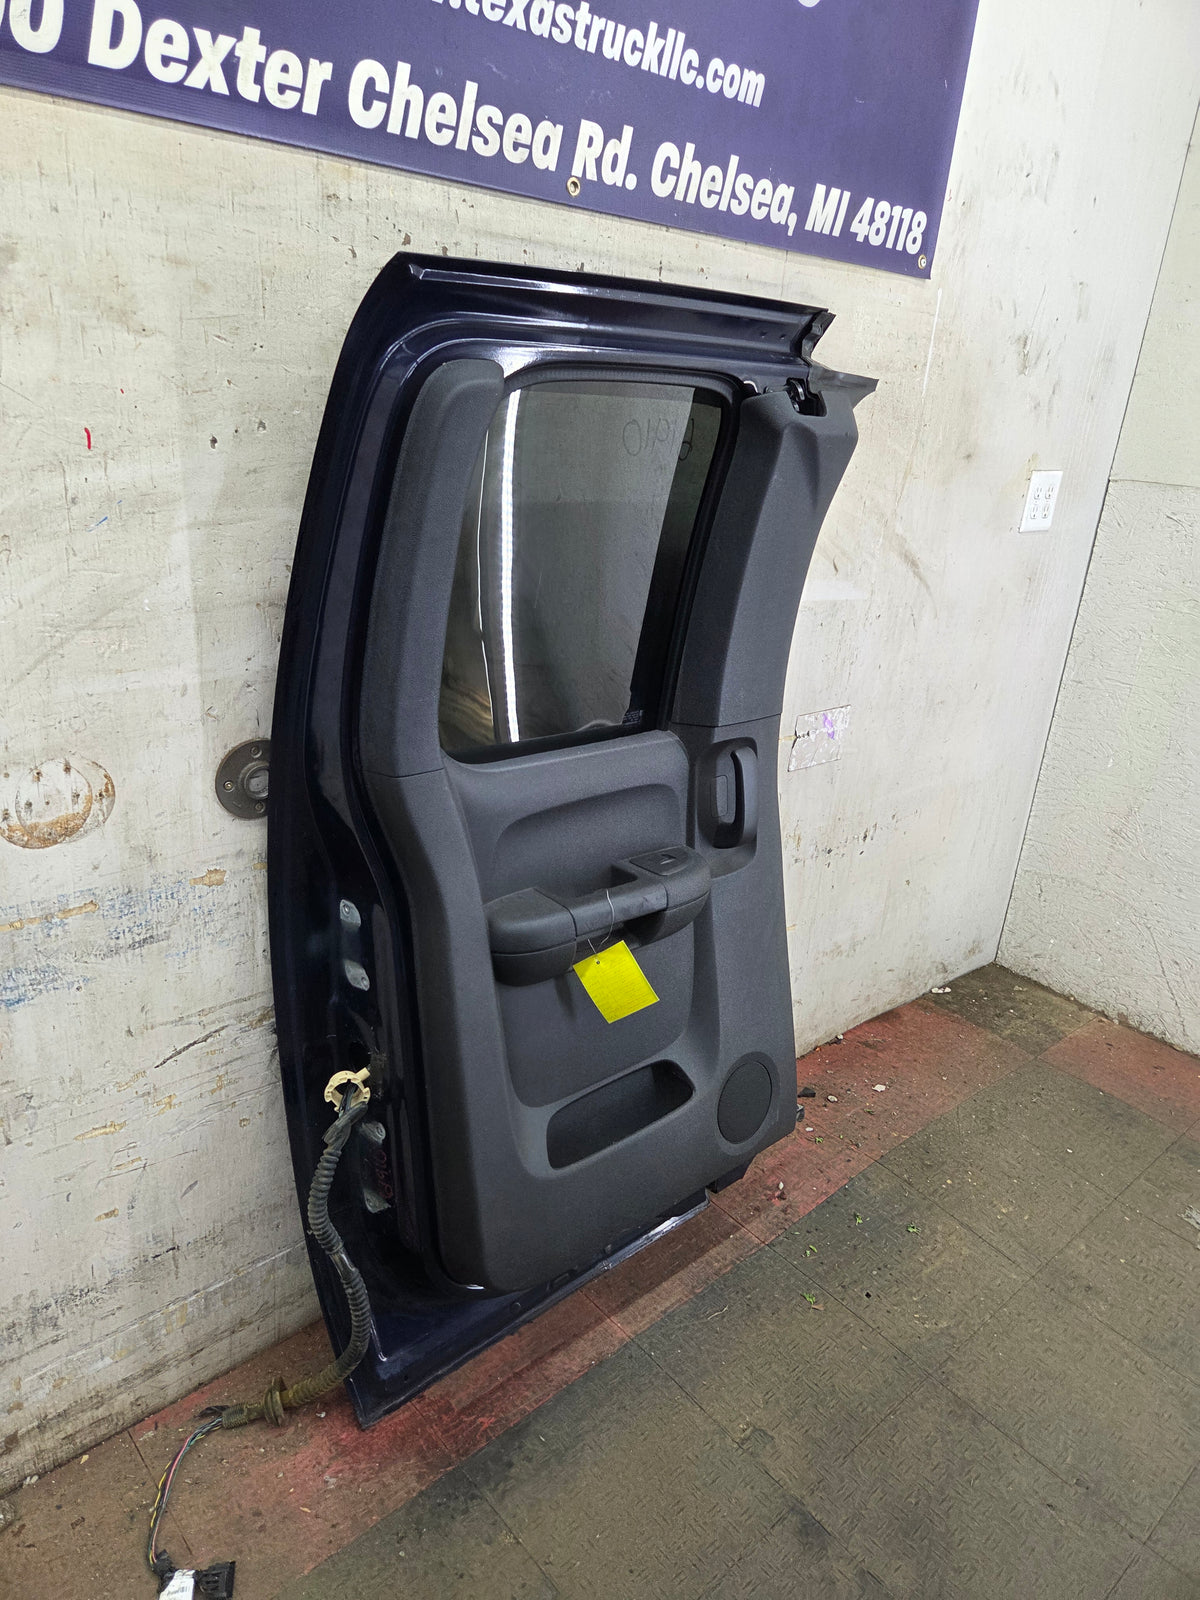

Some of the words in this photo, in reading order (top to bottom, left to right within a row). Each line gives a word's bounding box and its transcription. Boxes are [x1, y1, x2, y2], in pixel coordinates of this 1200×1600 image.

[0, 0, 64, 53] 0
[88, 0, 332, 116] Dexter
[348, 58, 564, 172] Chelsea
[571, 118, 637, 191] Rd.
[651, 141, 797, 236] Chelsea,
[804, 183, 850, 237] MI
[850, 197, 927, 254] 48118
